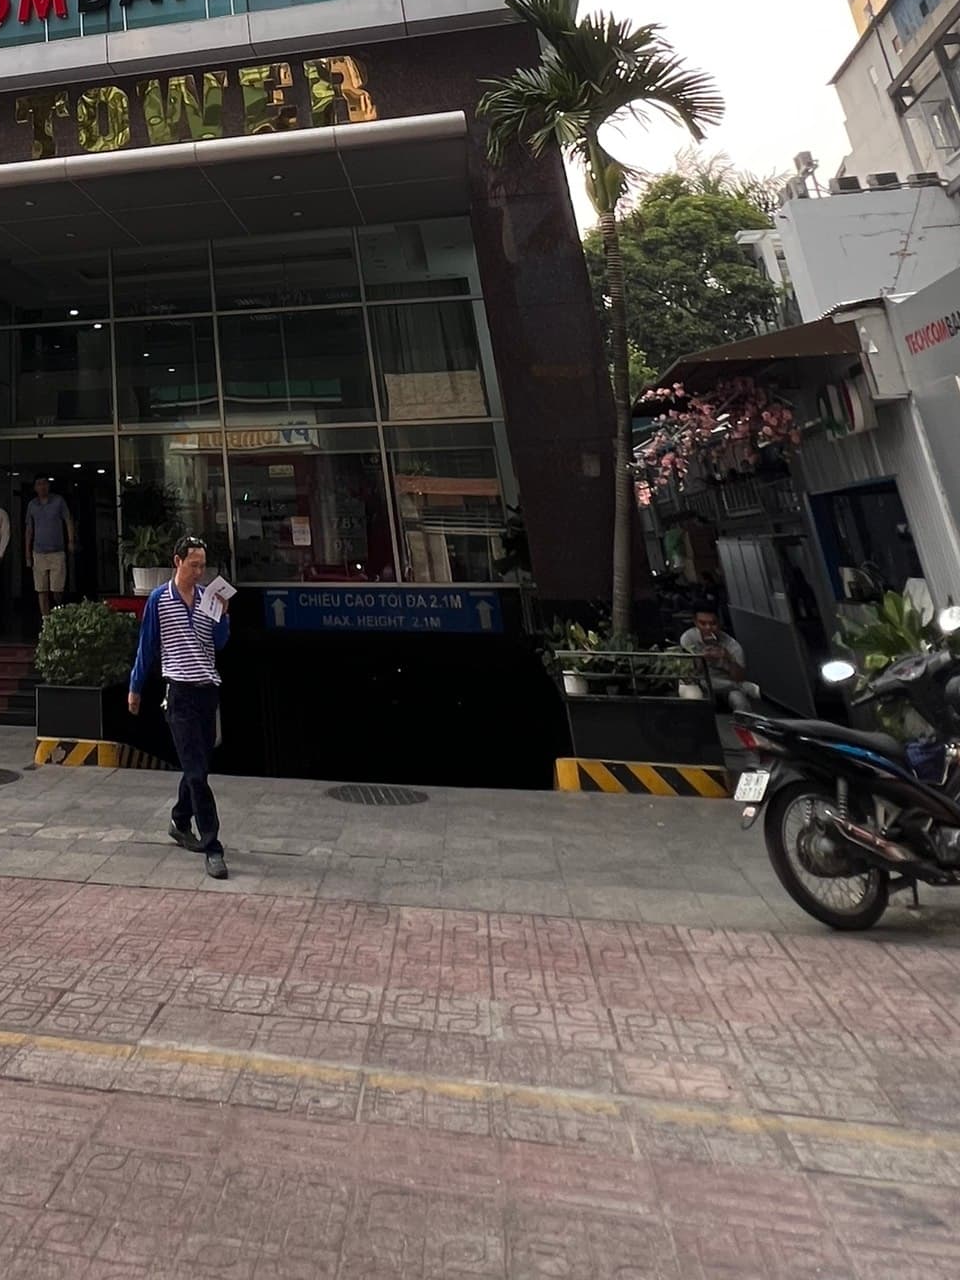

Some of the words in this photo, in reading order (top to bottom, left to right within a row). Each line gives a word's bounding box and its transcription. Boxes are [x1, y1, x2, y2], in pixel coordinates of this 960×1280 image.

[15, 55, 378, 158] TOWER
[344, 593, 375, 608] CAO
[429, 593, 462, 609] 2.1M
